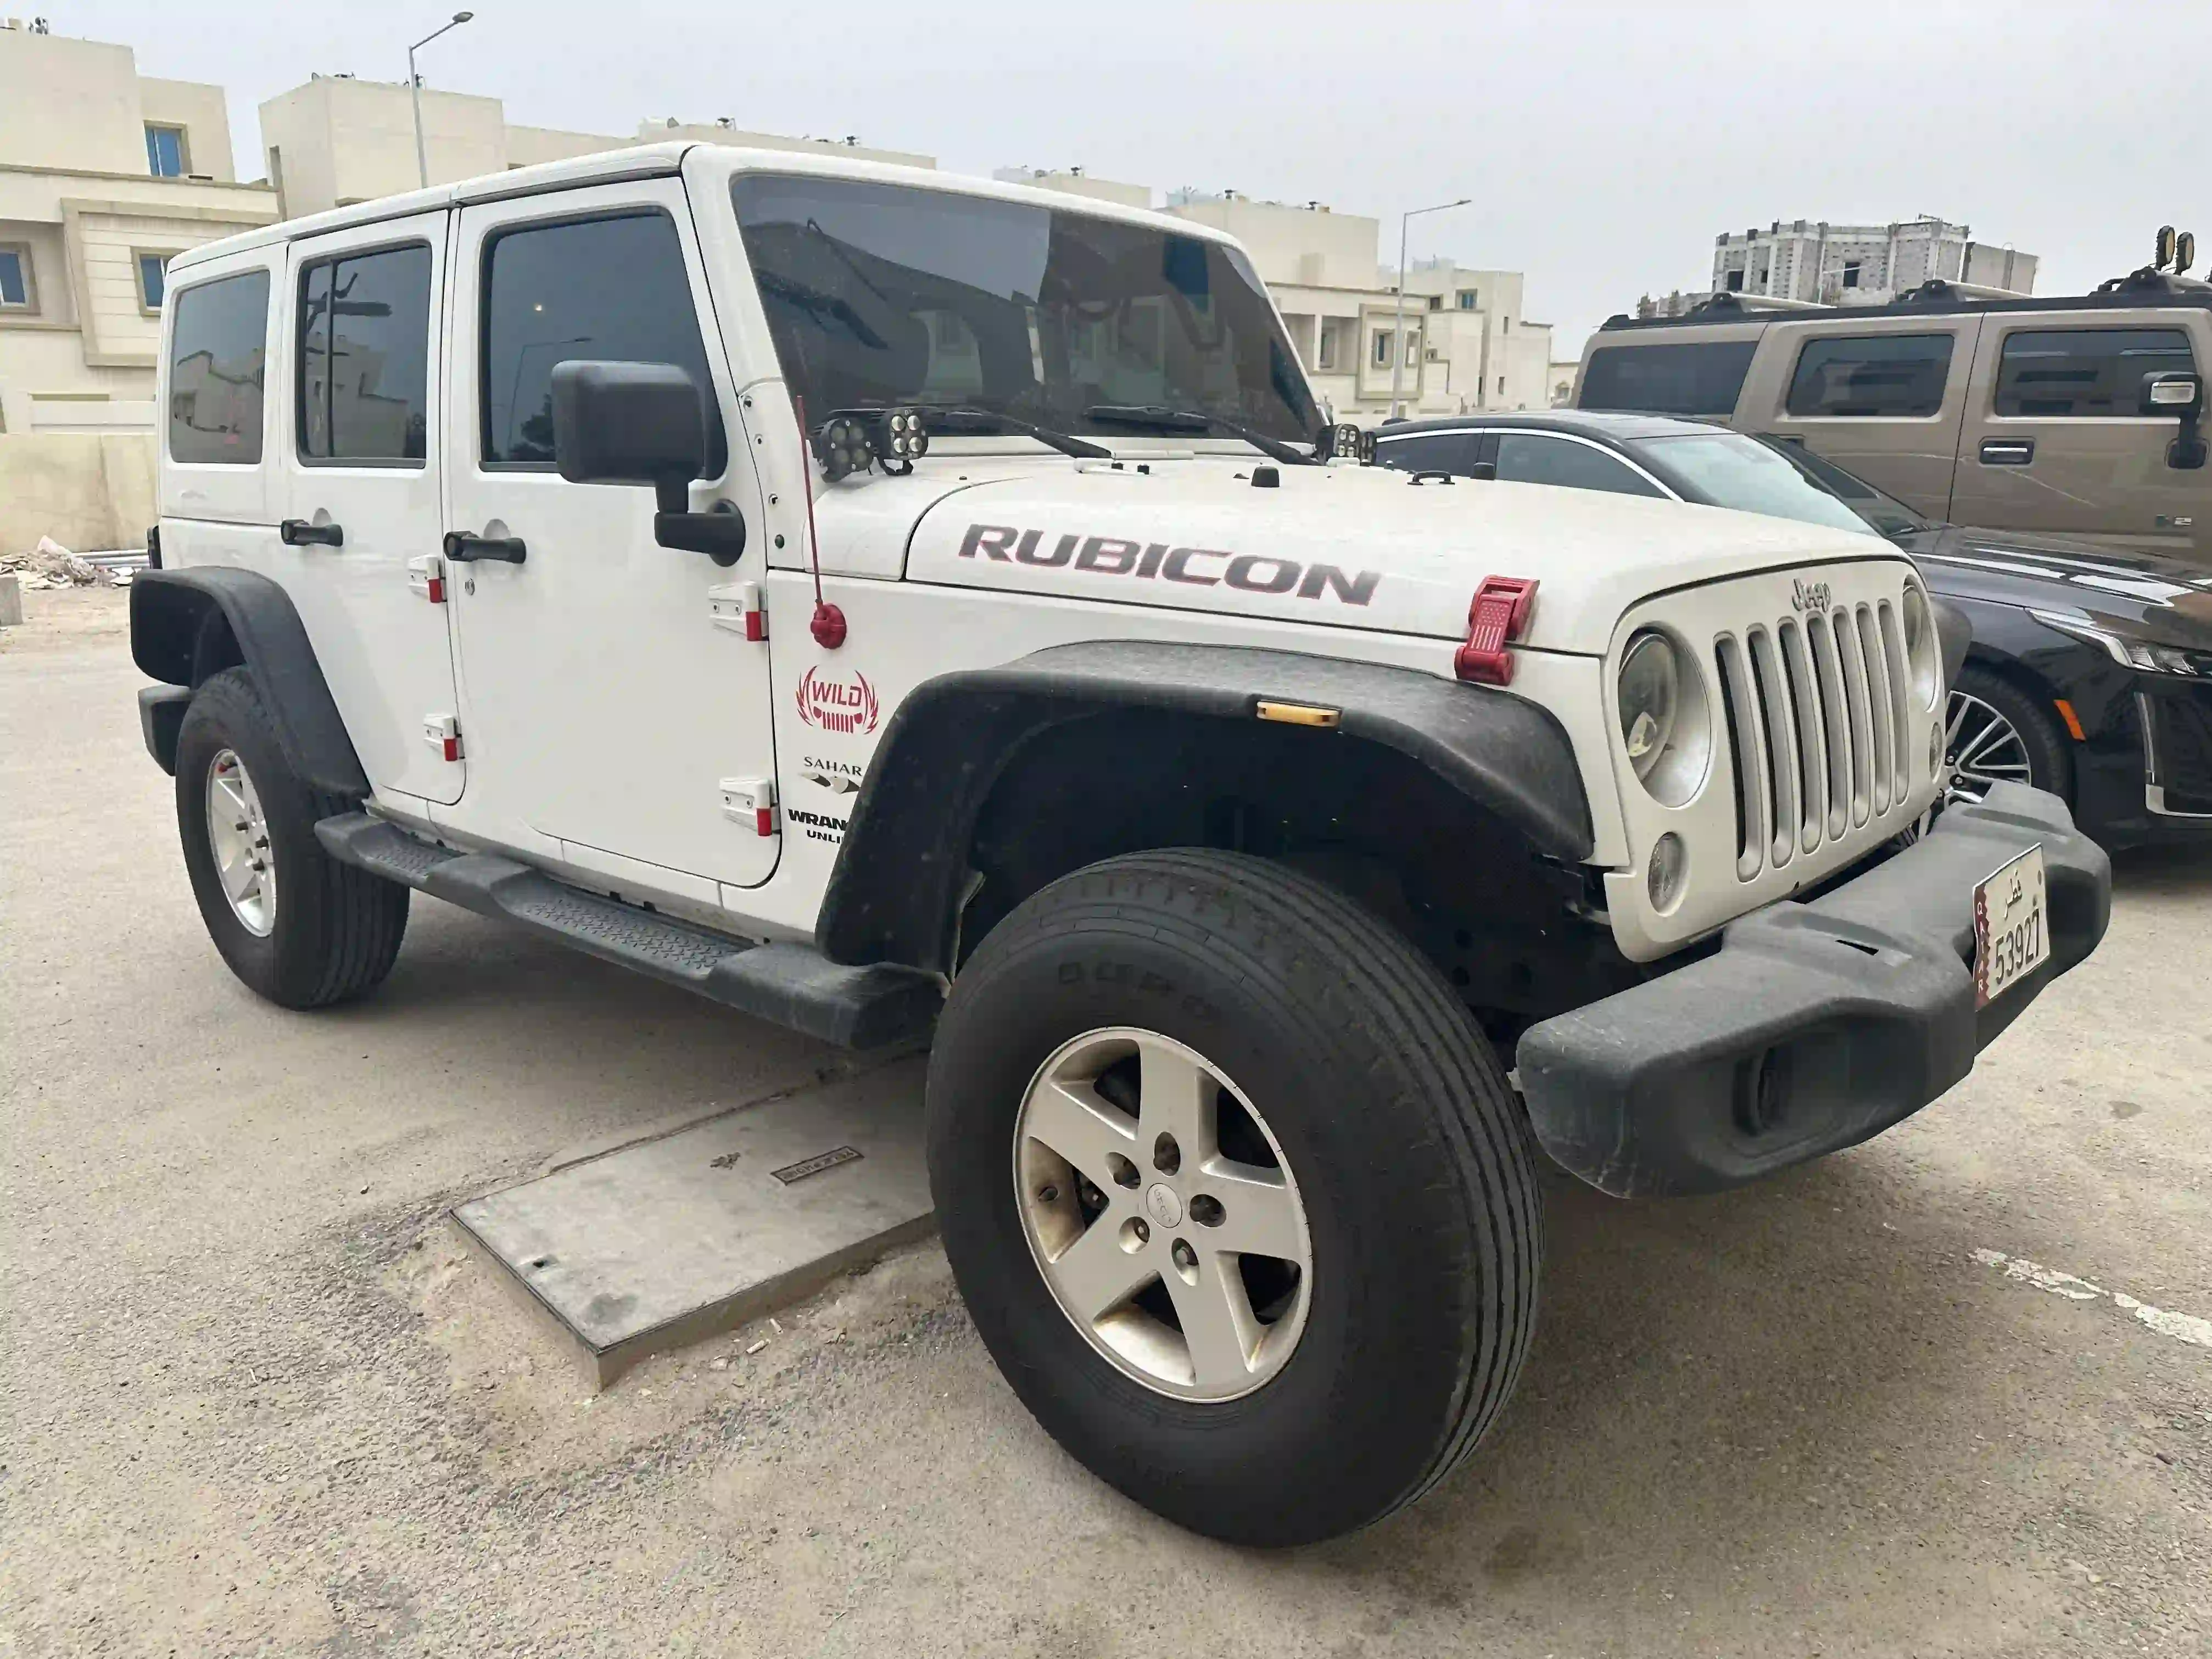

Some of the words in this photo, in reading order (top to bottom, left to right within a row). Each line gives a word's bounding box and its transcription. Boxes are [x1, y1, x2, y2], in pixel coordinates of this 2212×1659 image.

[958, 523, 1381, 606] RUBICON
[1791, 578, 1831, 612] Jeep
[812, 680, 862, 707] WILD
[803, 756, 862, 777] SAHAR
[787, 808, 848, 831] WRAN
[806, 829, 844, 844] UNLI
[2002, 869, 2023, 921] قطر
[1994, 907, 2040, 985] 53927
